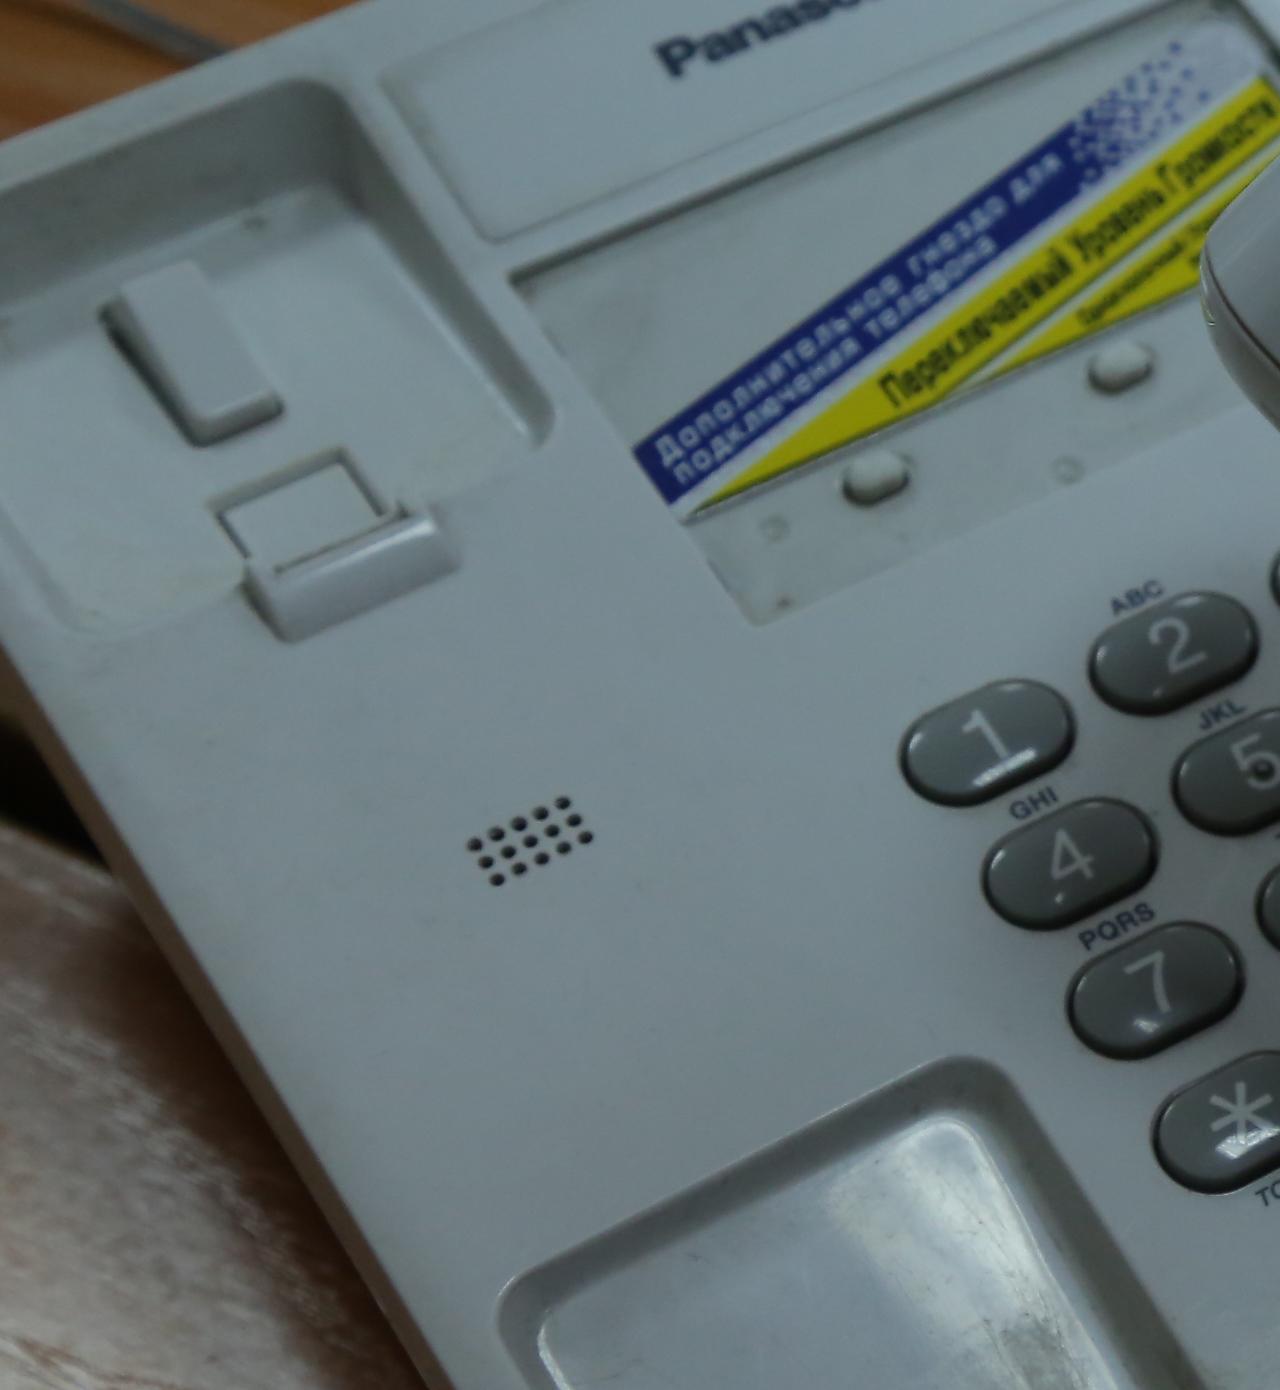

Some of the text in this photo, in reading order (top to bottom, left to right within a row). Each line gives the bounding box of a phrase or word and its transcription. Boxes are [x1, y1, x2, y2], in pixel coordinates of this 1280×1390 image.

[655, 0, 864, 77] Panas
[878, 246, 1074, 409] Переключаемый
[1069, 188, 1166, 264] Уровень
[1157, 98, 1278, 195] Громкости
[654, 152, 1064, 468] Дополнительное гнездо для
[673, 336, 863, 486] подключения
[864, 235, 998, 339] телефона
[1110, 580, 1164, 616] ABC
[1147, 616, 1208, 674] 2
[962, 708, 1030, 778] 1
[1198, 700, 1246, 730] JKL
[1008, 786, 1058, 821] GHI
[1049, 828, 1095, 882] 4
[1078, 903, 1155, 951] PQRS
[1123, 950, 1172, 1014] 7
